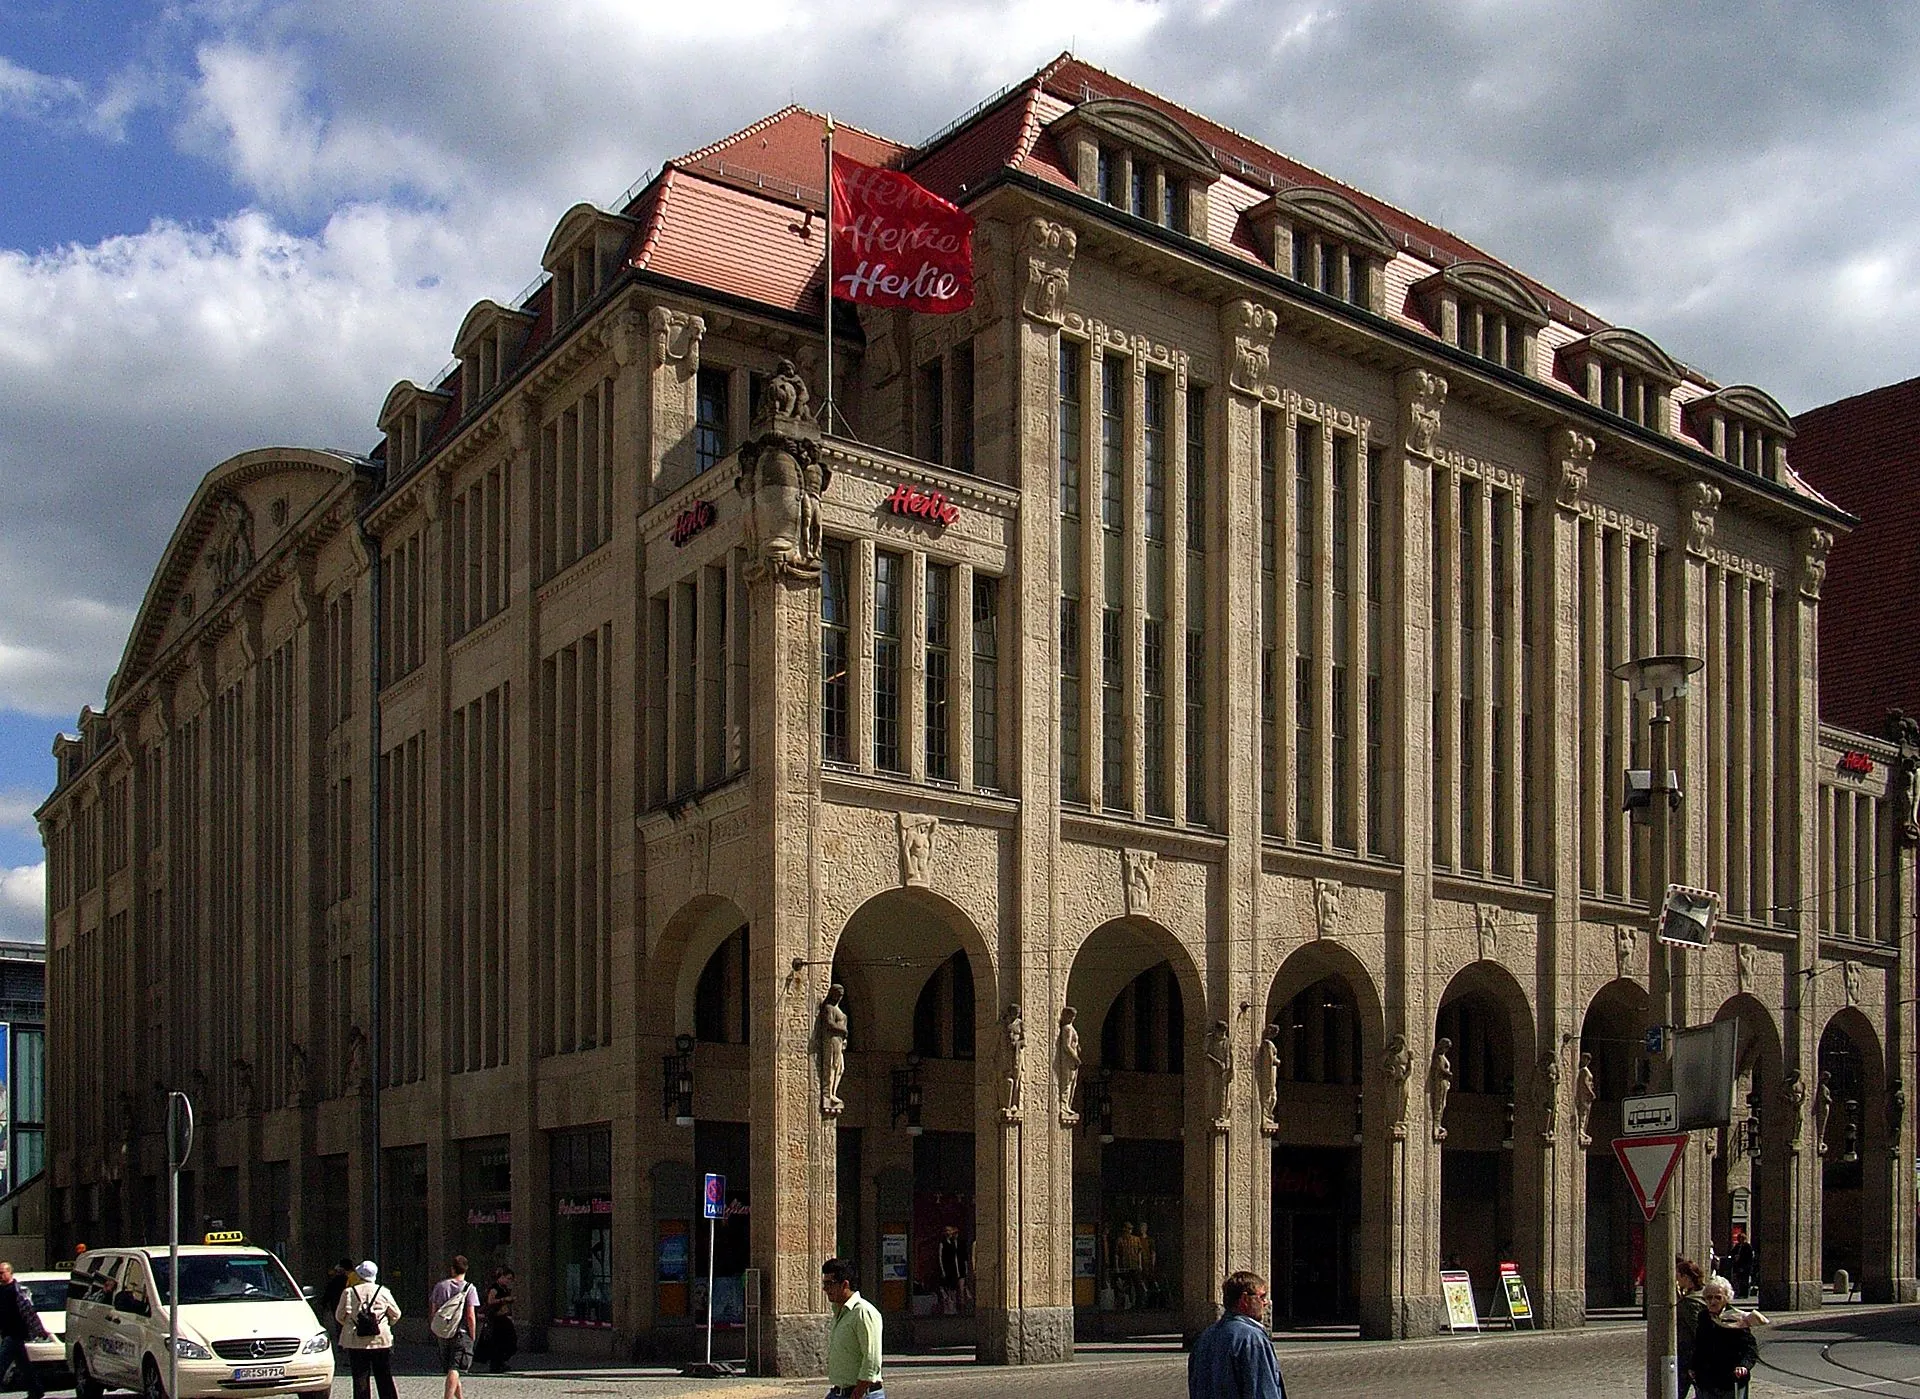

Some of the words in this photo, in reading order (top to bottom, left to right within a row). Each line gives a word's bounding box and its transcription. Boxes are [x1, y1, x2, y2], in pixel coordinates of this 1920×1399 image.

[842, 214, 960, 254] Hertie
[839, 260, 960, 300] Hertie
[887, 483, 961, 524] Hertie
